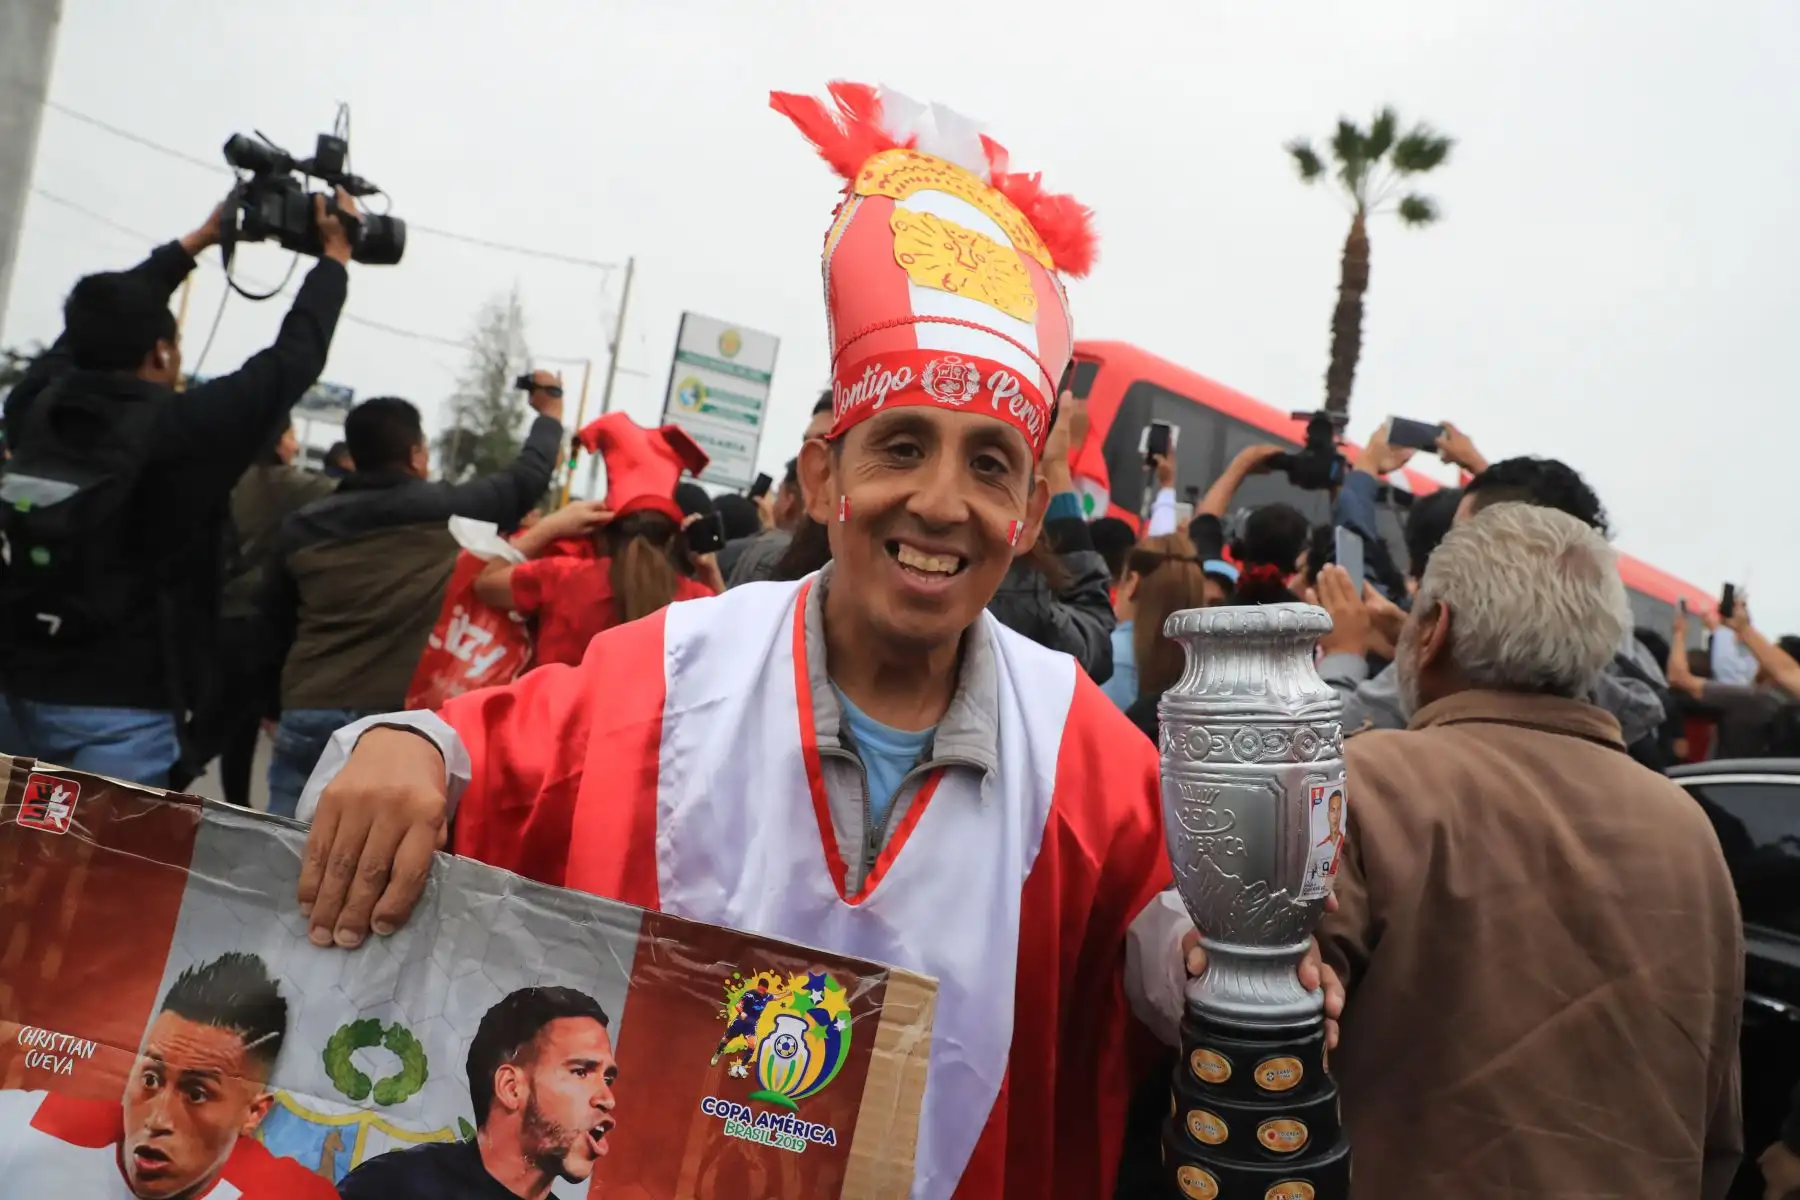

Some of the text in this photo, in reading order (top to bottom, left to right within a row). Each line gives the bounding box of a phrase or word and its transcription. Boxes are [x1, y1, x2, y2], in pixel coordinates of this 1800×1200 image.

[18, 1025, 97, 1059] CHRISTIAN
[25, 1049, 73, 1076] CUEVA
[702, 1096, 837, 1147] COPA AMÉRICA
[724, 1120, 806, 1153] BRASIL 2019
